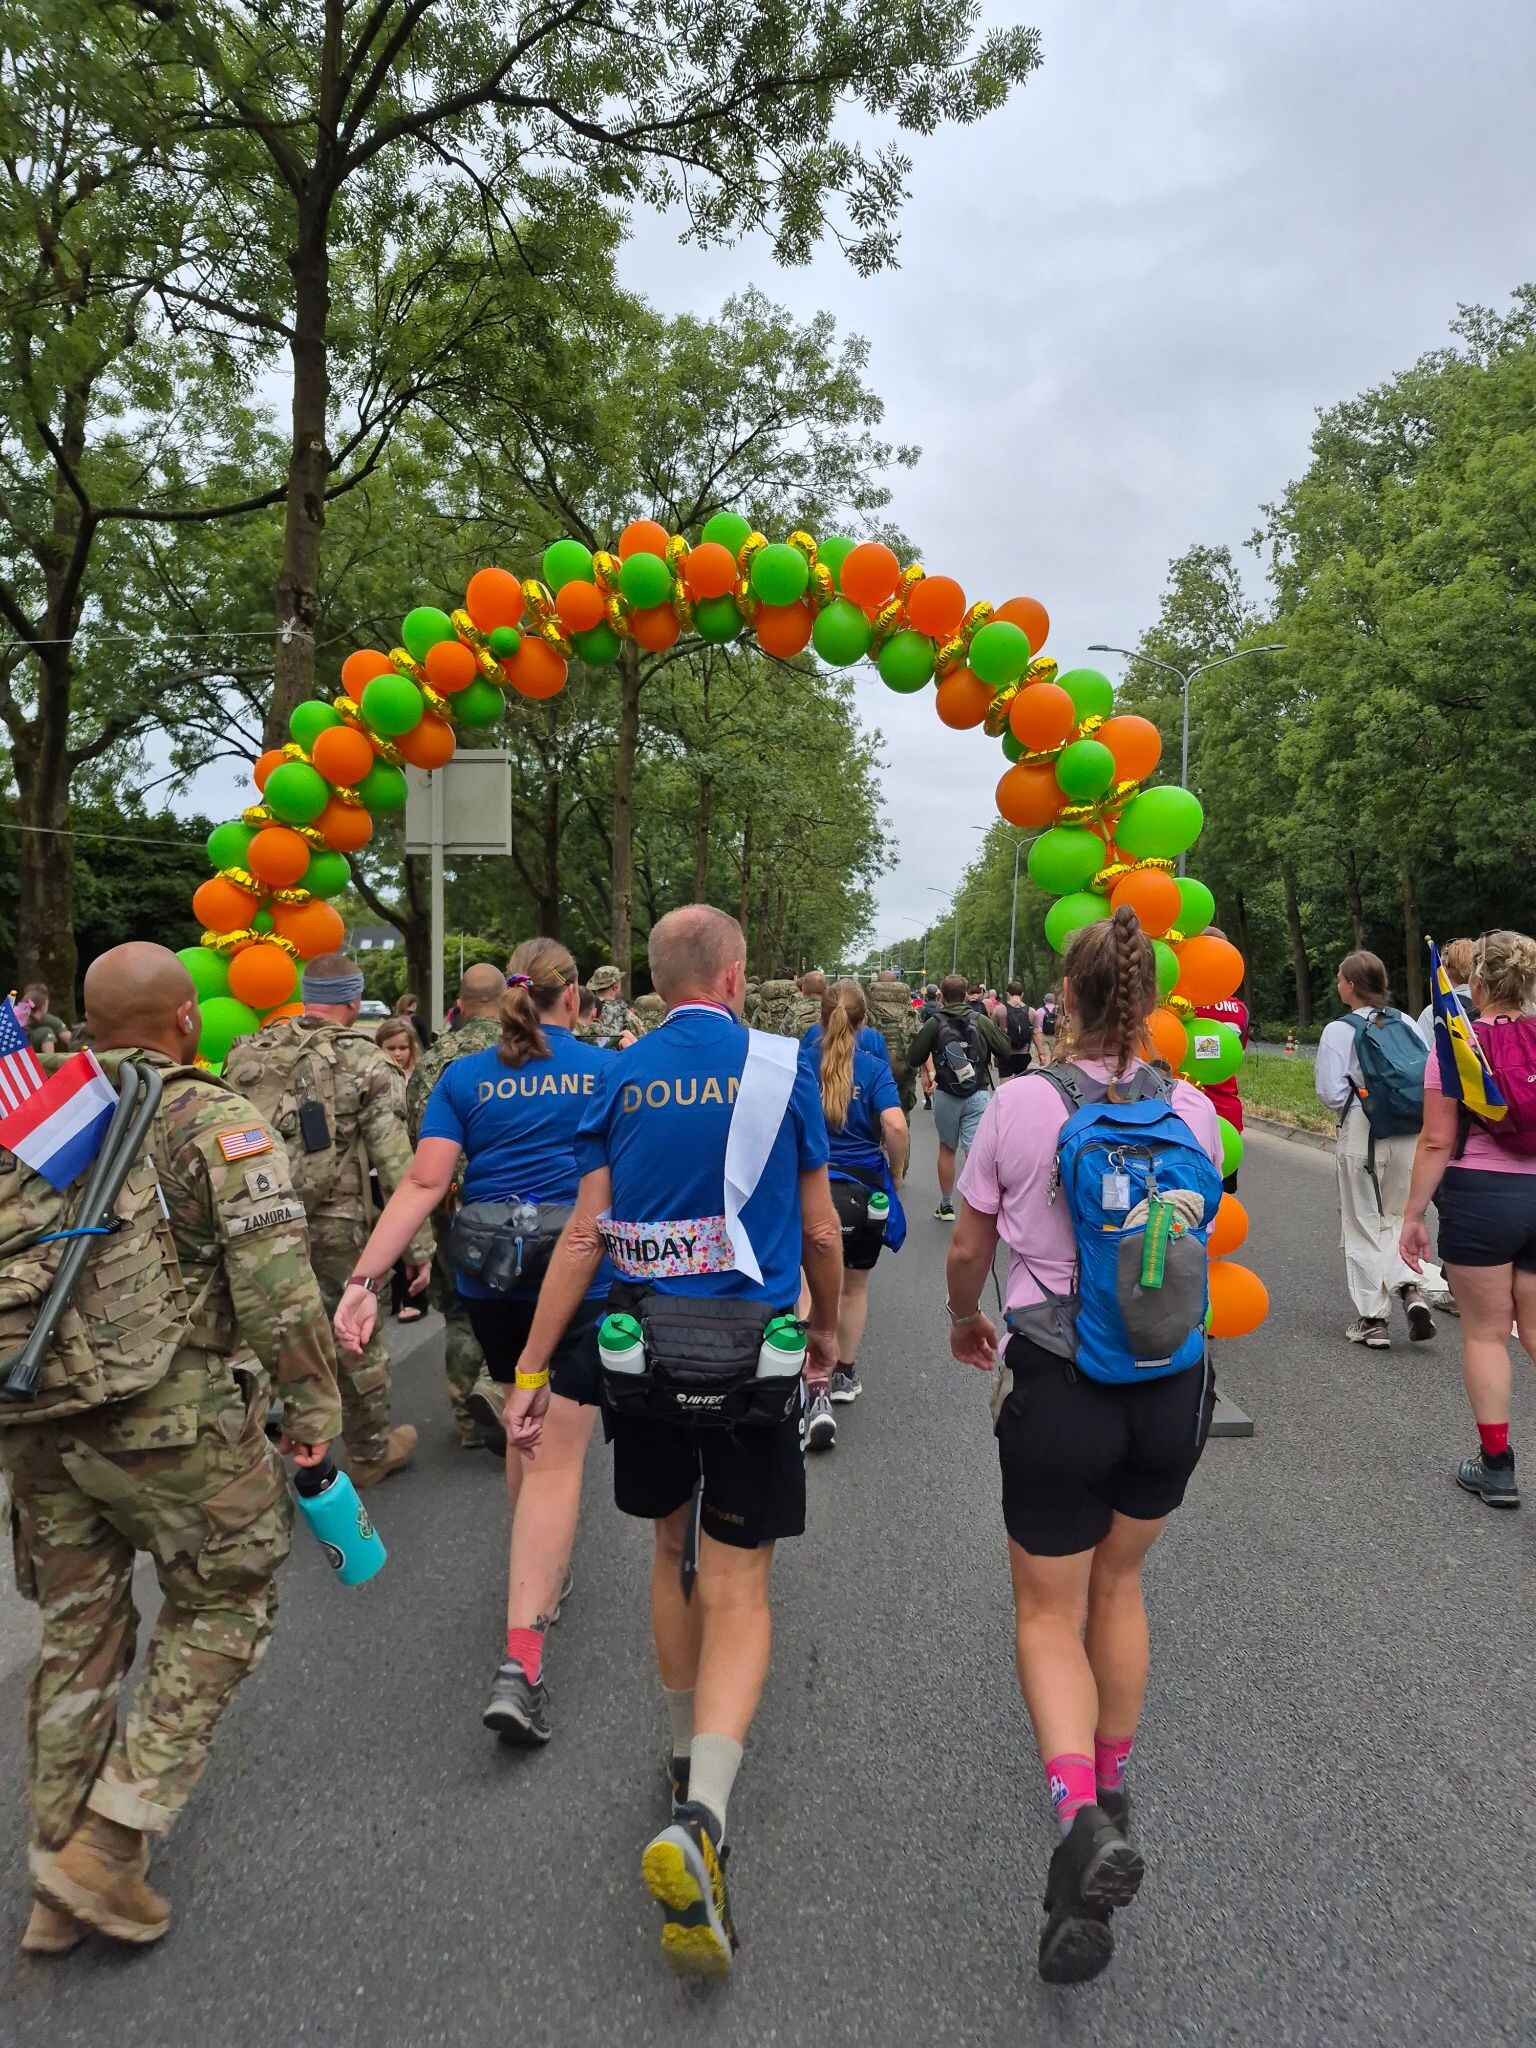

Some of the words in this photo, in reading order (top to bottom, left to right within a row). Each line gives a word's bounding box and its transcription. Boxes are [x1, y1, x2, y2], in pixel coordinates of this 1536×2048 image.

[478, 1073, 596, 1102] DOUANE
[623, 1077, 741, 1113] DOUAN
[241, 1207, 292, 1231] ZAMORA
[601, 1233, 697, 1262] IRTHDAY
[686, 1395, 725, 1405] HI-TEC
